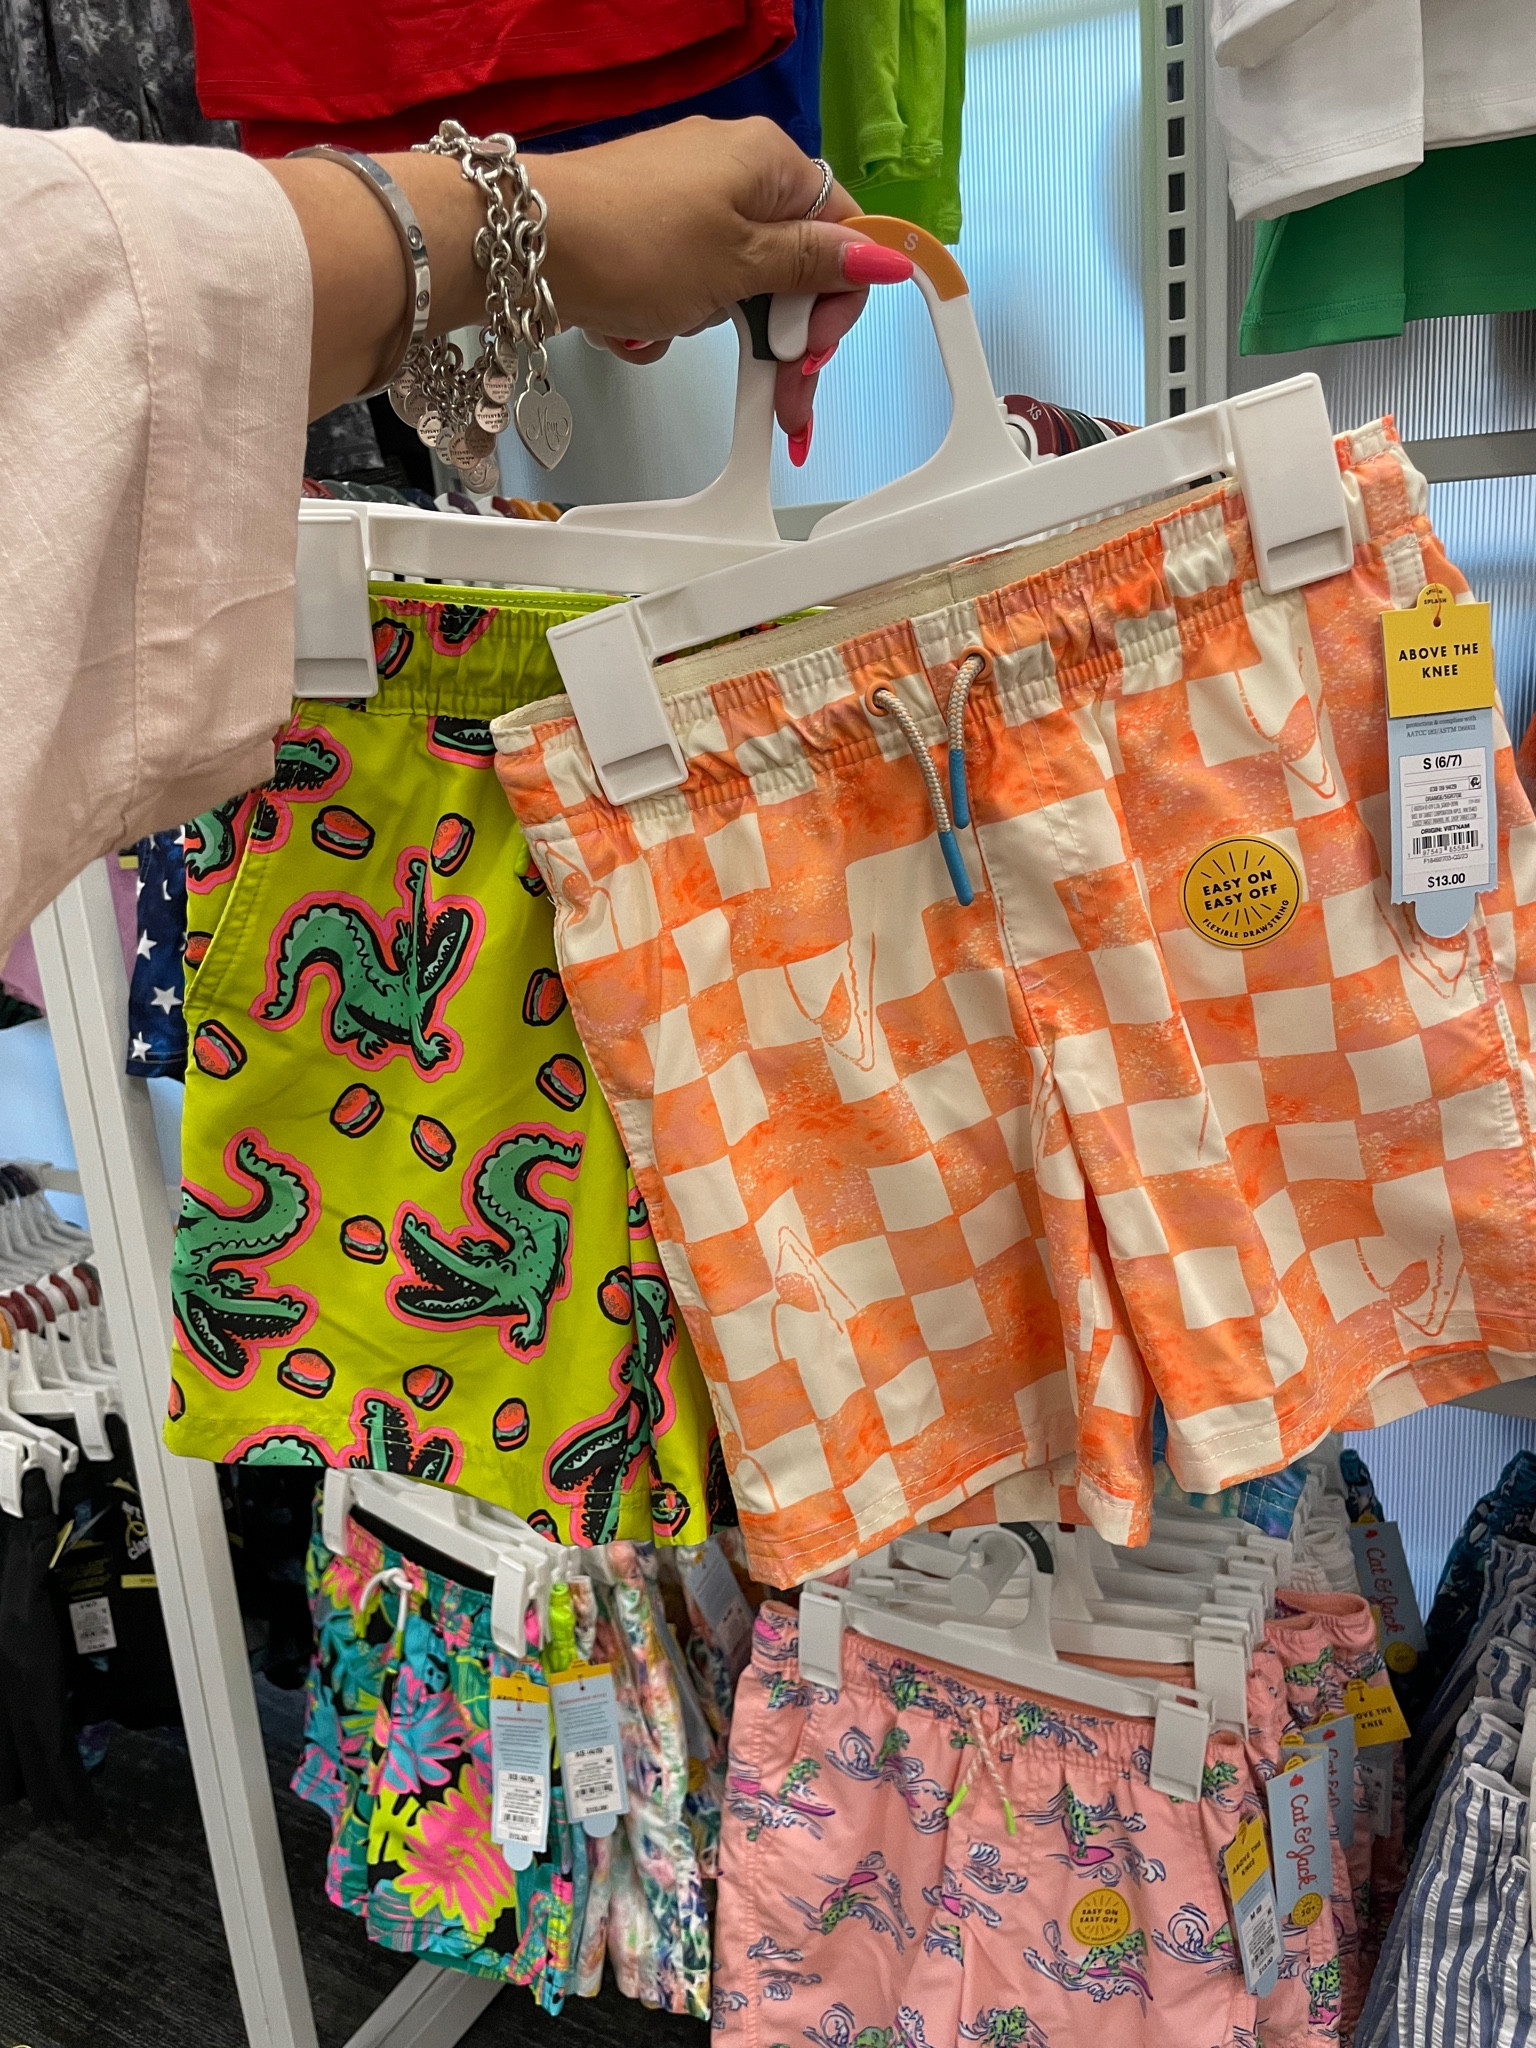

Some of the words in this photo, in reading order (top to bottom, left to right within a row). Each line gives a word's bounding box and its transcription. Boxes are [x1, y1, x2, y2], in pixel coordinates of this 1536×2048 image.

[904, 233, 919, 251] S
[1026, 402, 1042, 420] XS
[1398, 645, 1447, 662] ABOVE
[1453, 642, 1479, 656] THE
[1422, 663, 1458, 679] KNEE
[1423, 757, 1432, 770] S
[1435, 754, 1462, 768] (6/7)
[1443, 823, 1471, 832] VIETNAM
[1203, 877, 1241, 896] EASY
[1247, 869, 1273, 884] ON
[1427, 872, 1466, 888] $13.00
[1204, 892, 1243, 911] EASY
[1249, 883, 1278, 899] OFF
[1202, 918, 1239, 938] FLEXIBLE
[1243, 899, 1290, 938] DRAWSTRING
[1366, 1547, 1387, 1576] Cat
[1374, 1577, 1393, 1594] &
[1368, 1595, 1406, 1636] Jack
[1291, 1793, 1310, 1828] Cat
[1293, 1826, 1313, 1845] &
[1286, 1844, 1318, 1890] Jack
[1104, 1908, 1119, 1916] ON
